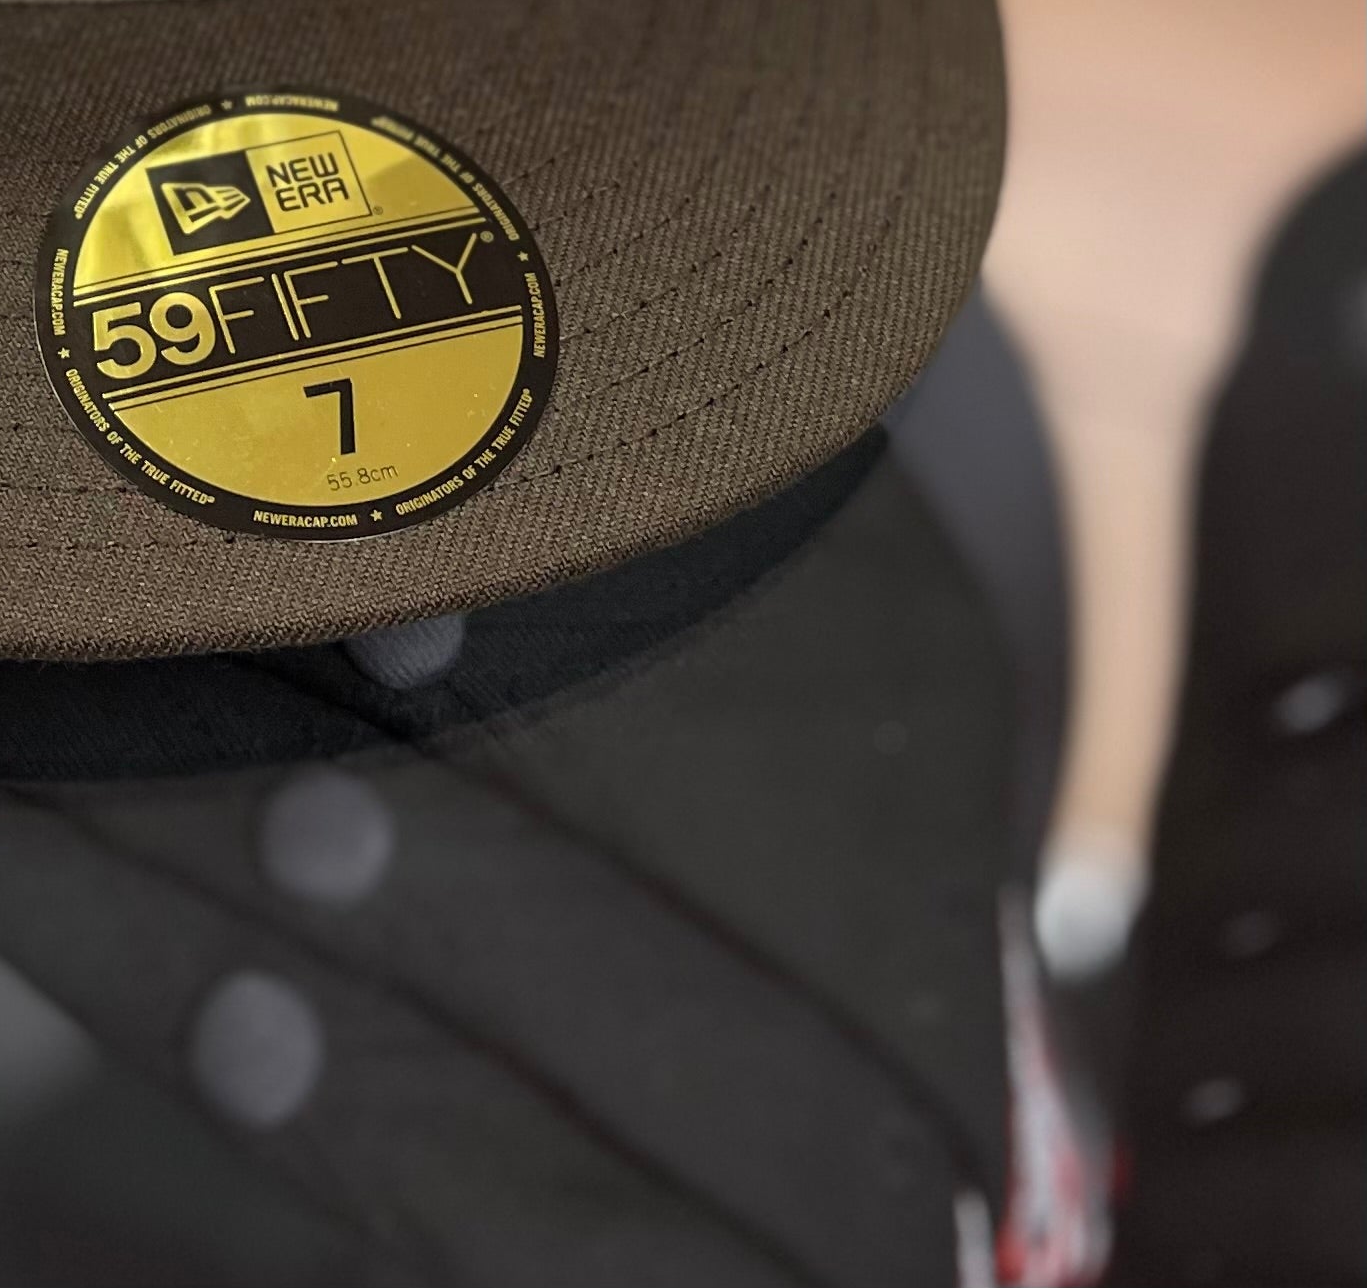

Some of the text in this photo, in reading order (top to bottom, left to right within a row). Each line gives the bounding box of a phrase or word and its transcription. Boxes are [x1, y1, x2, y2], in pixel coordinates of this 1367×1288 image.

[114, 145, 136, 163] THE
[134, 134, 149, 149] OF
[93, 161, 119, 185] TRUE
[265, 151, 340, 189] NEW
[275, 177, 350, 212] ERA
[51, 248, 69, 337] NEWERACAP.COM
[524, 272, 547, 358] NEWERACAP.COM
[65, 368, 111, 433] ORIGINATORS
[106, 430, 124, 445] OF
[119, 442, 143, 465] THE
[140, 459, 171, 486] TRUE
[302, 376, 357, 457] 7
[326, 464, 399, 492] 55.8cm
[395, 475, 465, 516] ORIGINATORS
[461, 464, 478, 481] OF
[473, 448, 497, 469] THE
[490, 424, 517, 451] TRUE
[252, 509, 359, 528] NEWERACAP.COM
